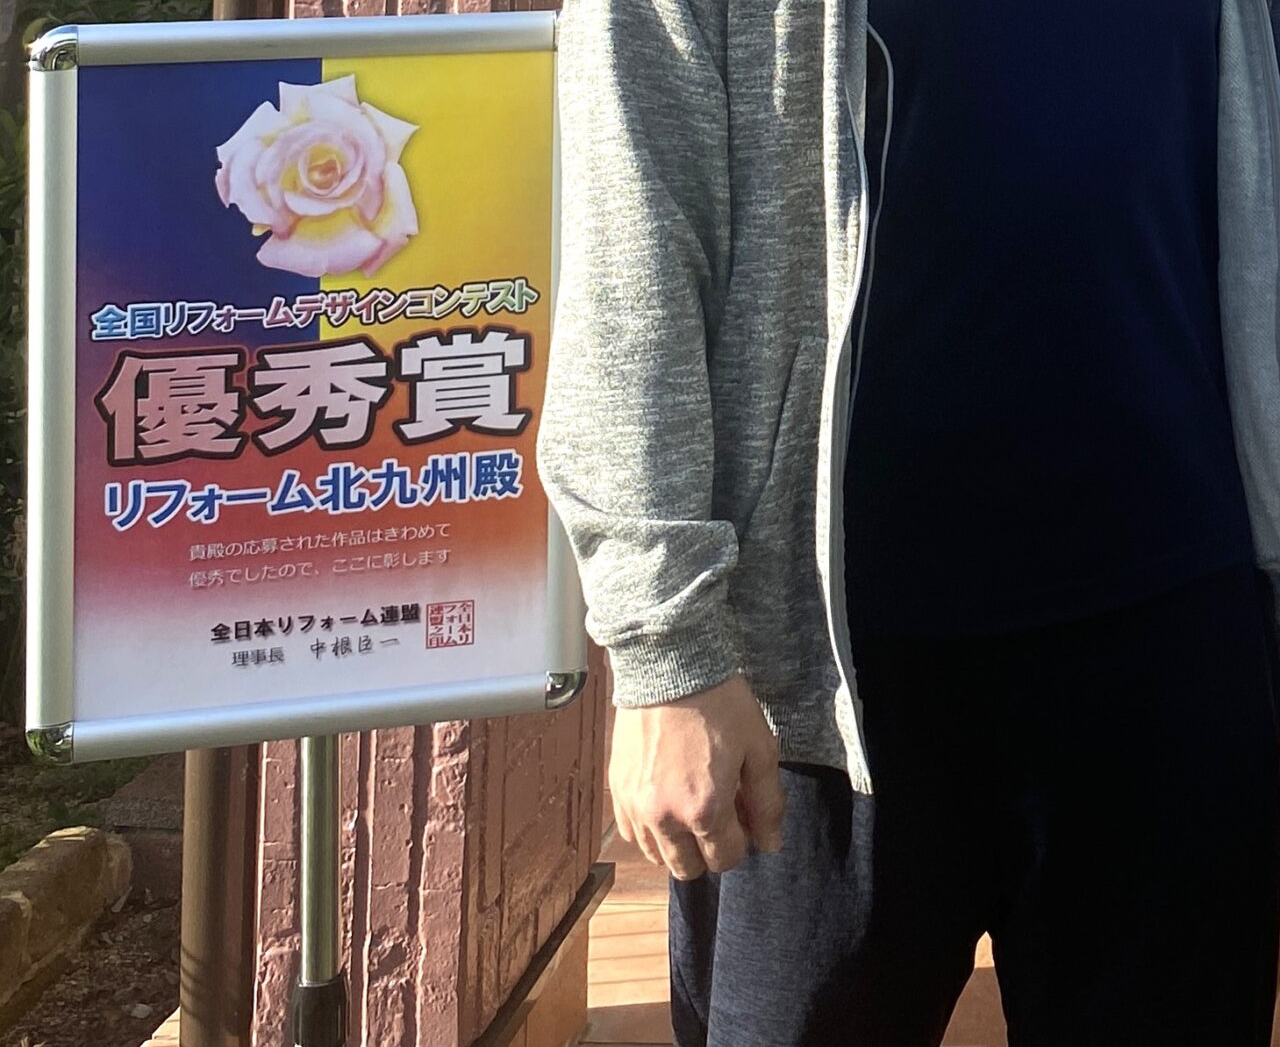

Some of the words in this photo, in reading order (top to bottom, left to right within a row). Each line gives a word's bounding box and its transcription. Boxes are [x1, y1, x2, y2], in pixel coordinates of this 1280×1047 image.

[91, 278, 538, 340] 全国リフォームデザインコンテスト
[98, 329, 529, 463] 優秀賞
[104, 449, 523, 531] リフォーム北九州殿
[189, 523, 452, 562] 貴殿の応募された作品はきわめて
[211, 602, 421, 641] 全日本リフォーム連盟
[232, 647, 286, 667] 理事長
